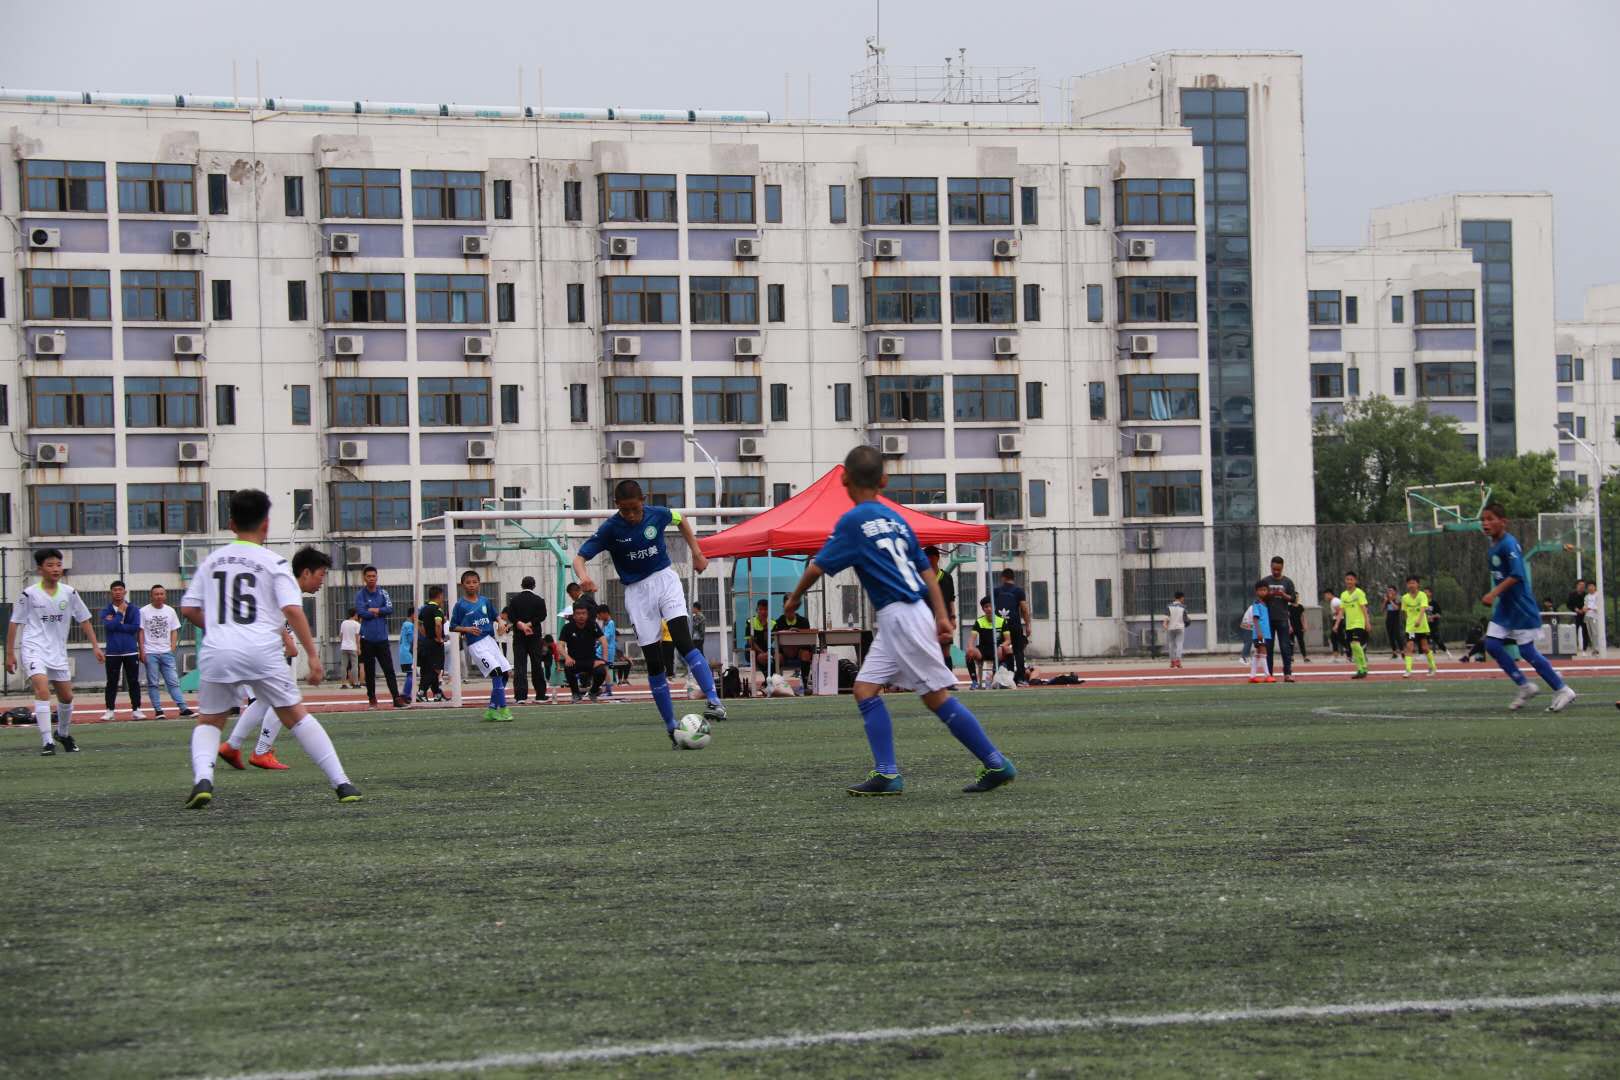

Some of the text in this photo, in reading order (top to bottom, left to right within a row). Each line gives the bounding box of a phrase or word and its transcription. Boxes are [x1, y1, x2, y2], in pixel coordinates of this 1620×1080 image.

[626, 545, 658, 561] 卡尔美
[213, 571, 257, 625] 16
[481, 658, 490, 669] 6
